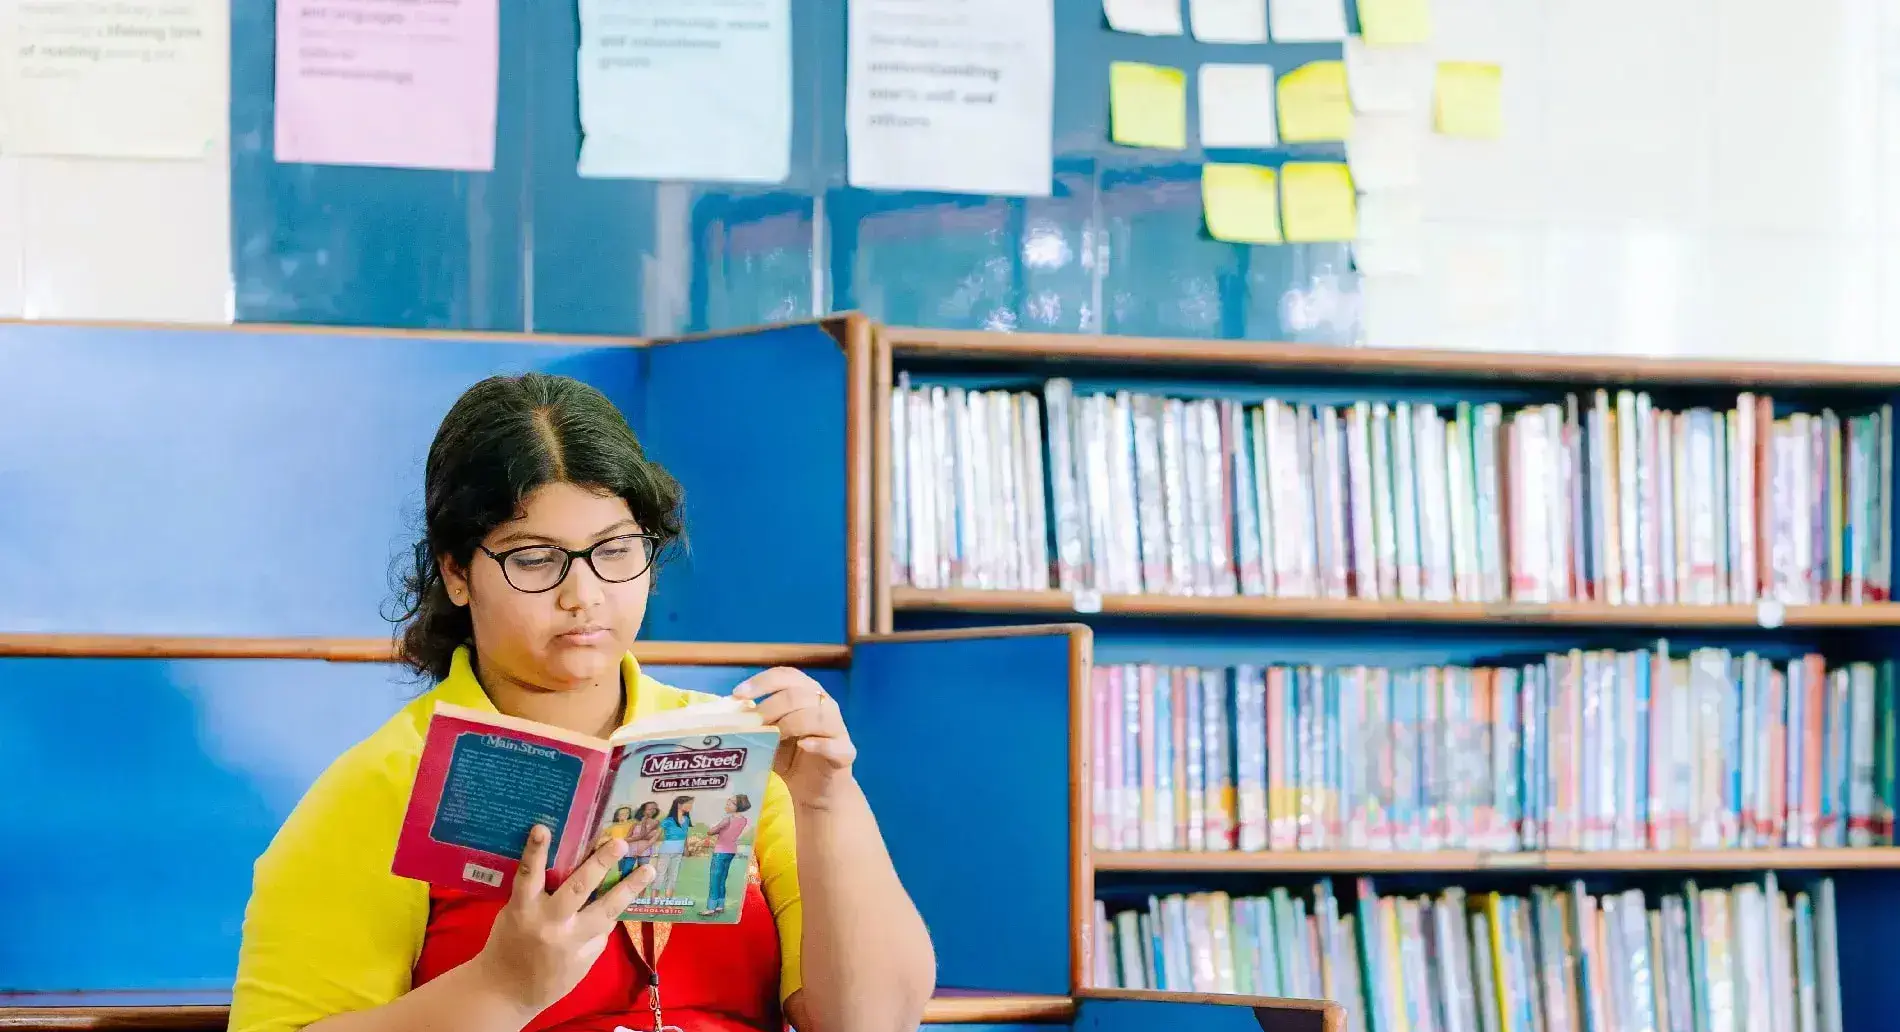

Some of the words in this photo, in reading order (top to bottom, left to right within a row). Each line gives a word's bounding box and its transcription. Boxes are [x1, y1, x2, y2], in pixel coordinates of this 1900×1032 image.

[486, 735, 518, 752] Main
[518, 742, 556, 760] Street
[649, 757, 688, 772] Main
[689, 753, 739, 769] Street
[658, 780, 677, 788] Ann
[691, 777, 721, 786] Martin
[653, 896, 694, 906] Friends
